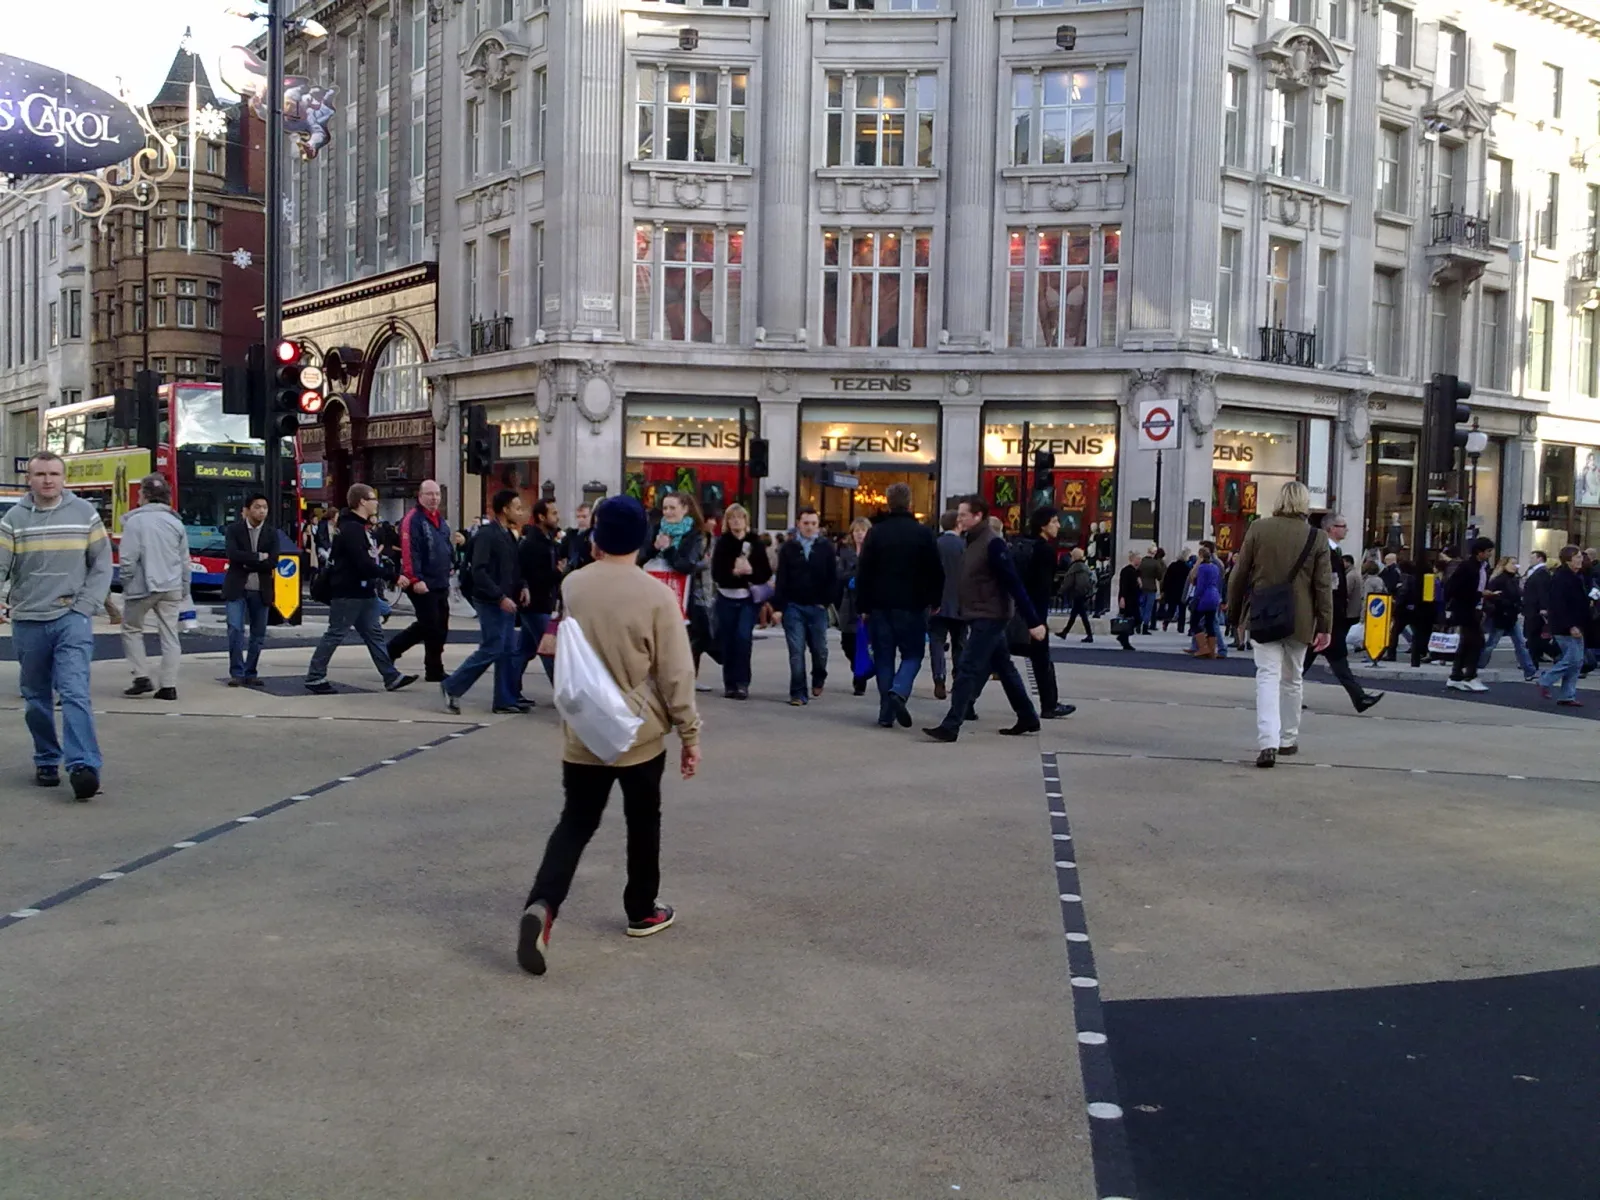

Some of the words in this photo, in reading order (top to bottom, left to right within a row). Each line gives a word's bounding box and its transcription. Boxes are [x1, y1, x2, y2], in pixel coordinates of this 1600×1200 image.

[17, 92, 121, 148] CAROL
[829, 375, 912, 391] TEZENIS
[640, 430, 741, 449] TEZENIS
[820, 434, 920, 453] TEZENIS
[196, 464, 219, 476] East
[222, 466, 252, 478] Acton
